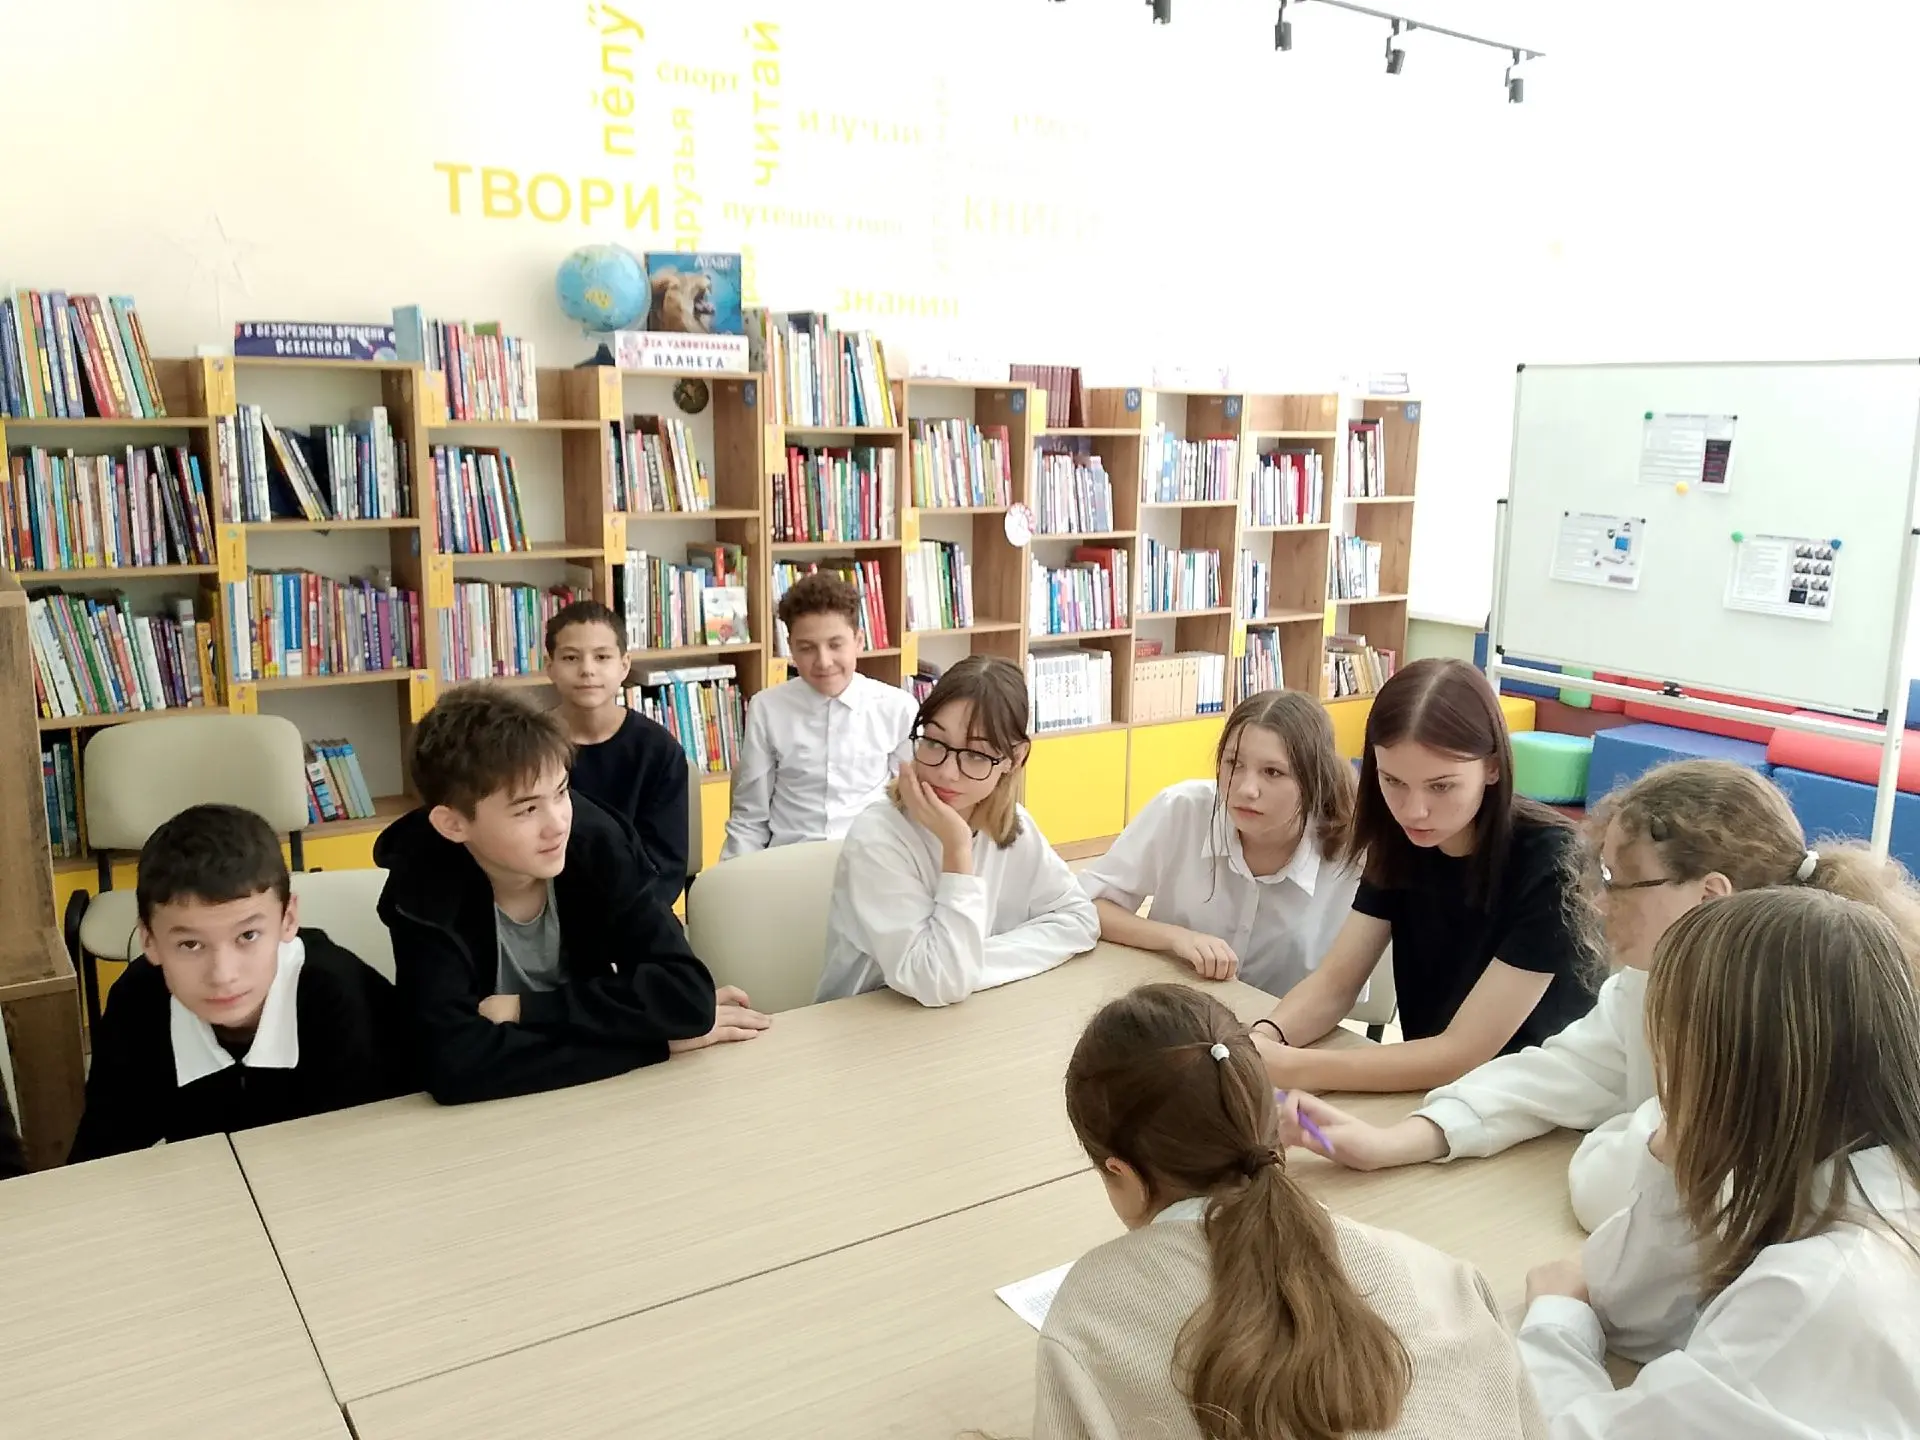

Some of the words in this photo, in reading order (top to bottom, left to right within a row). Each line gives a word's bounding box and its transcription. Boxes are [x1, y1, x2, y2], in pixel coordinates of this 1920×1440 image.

[656, 61, 741, 94] спорт
[743, 20, 781, 188] читай
[433, 161, 661, 232] ТВОРИ
[654, 353, 725, 370] ПЛАНЕТА
